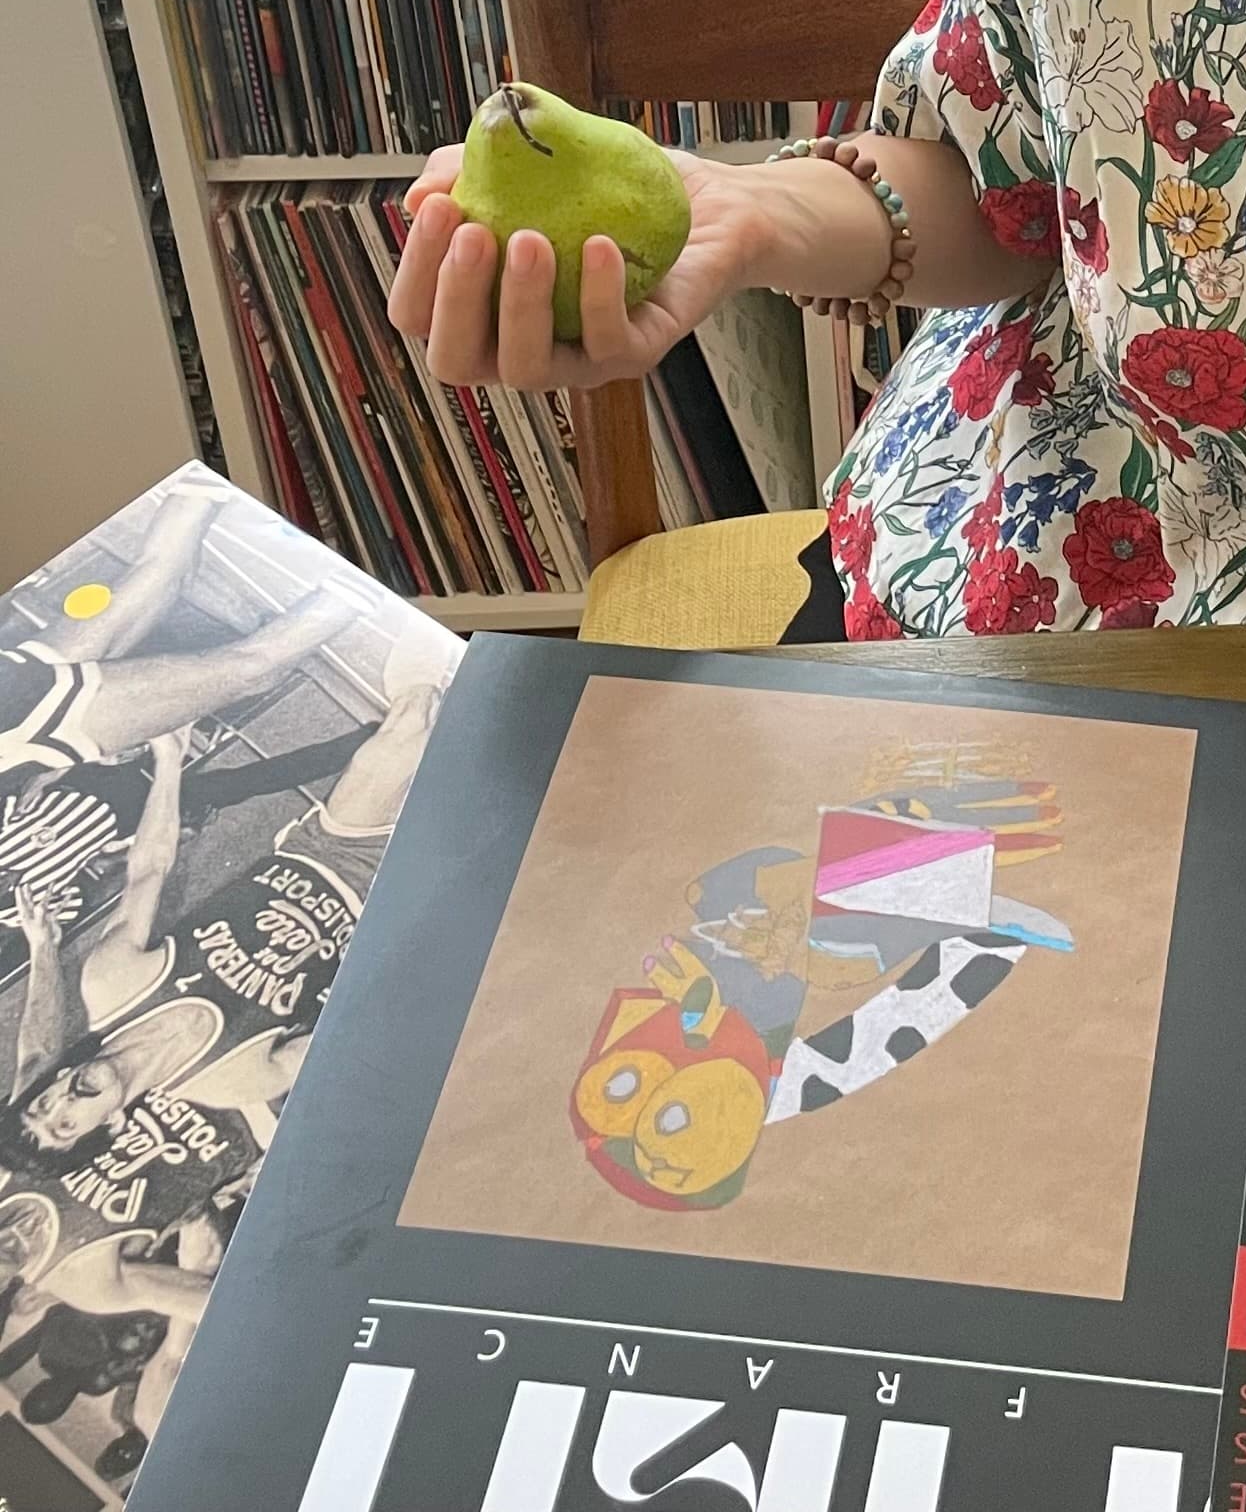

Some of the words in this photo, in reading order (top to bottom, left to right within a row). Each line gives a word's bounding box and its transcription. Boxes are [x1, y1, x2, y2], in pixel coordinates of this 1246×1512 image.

[193, 920, 308, 1016] PANTERAS
[253, 947, 279, 966] DE
[256, 899, 336, 975] Lara
[175, 972, 203, 993] 7
[108, 1107, 188, 1180] Lar
